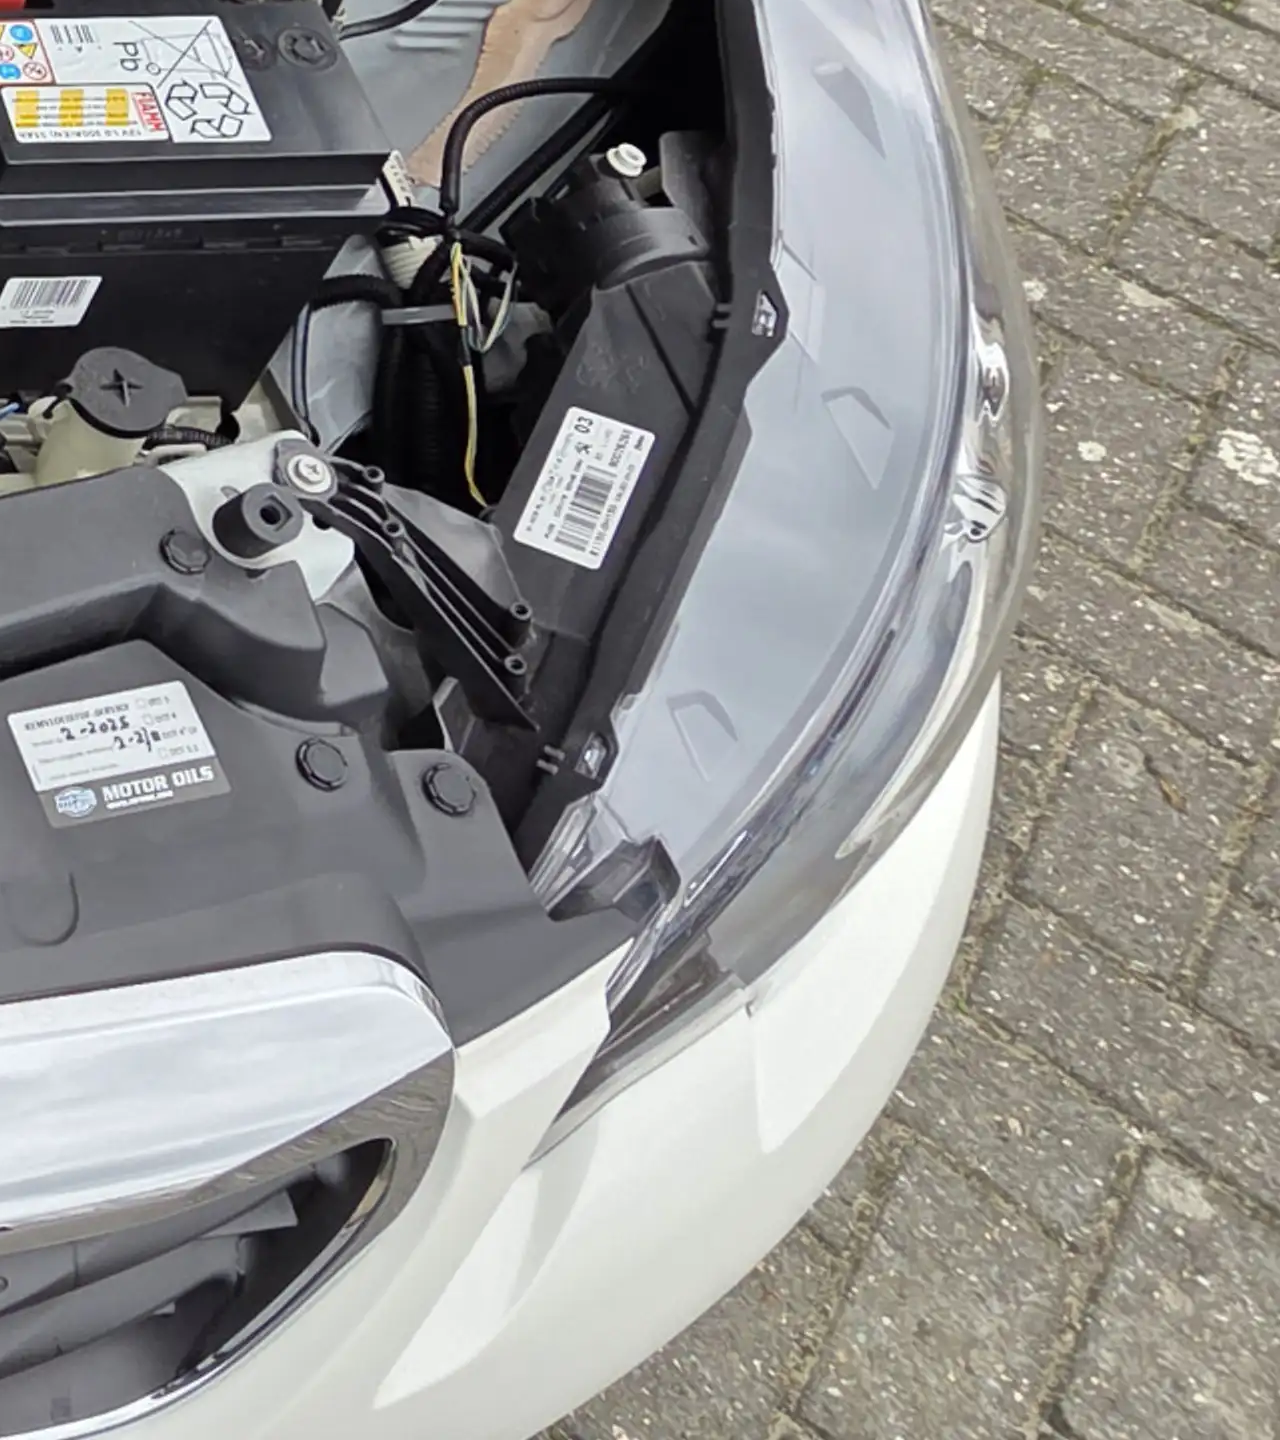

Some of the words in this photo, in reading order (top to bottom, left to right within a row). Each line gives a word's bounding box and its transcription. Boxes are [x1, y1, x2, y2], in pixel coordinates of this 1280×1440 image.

[113, 41, 140, 72] Pb
[573, 415, 594, 435] 03
[102, 772, 169, 802] MOTOR
[172, 765, 214, 787] OILS
